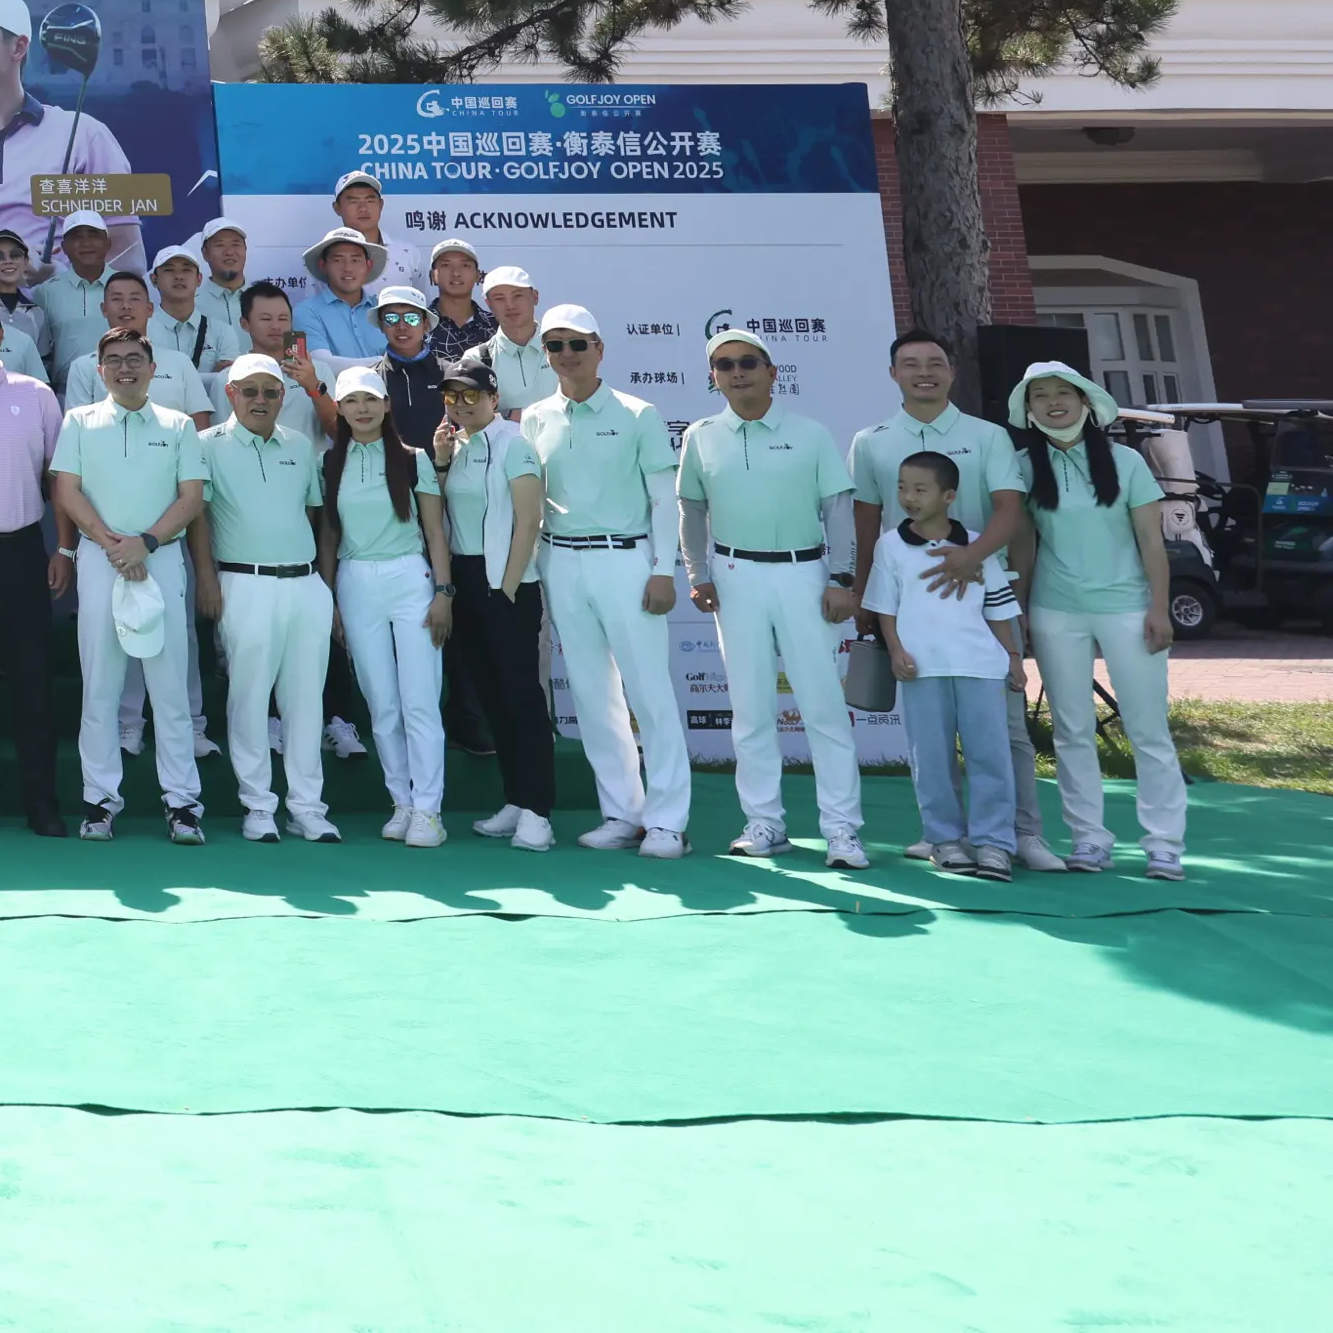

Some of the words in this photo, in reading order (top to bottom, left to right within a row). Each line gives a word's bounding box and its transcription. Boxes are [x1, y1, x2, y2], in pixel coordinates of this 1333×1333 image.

[450, 96, 518, 109] 中国巡回赛
[566, 94, 621, 105] GOLFJOY
[623, 94, 656, 105] OPEN
[360, 161, 429, 180] CHINA
[610, 161, 669, 179] OPEN
[673, 161, 724, 180] 2025
[38, 178, 107, 195] 查喜洋洋
[41, 199, 123, 213] SCHNEIDER
[129, 199, 157, 214] JAN
[405, 211, 446, 231] 鸣谢
[454, 212, 677, 229] ACKNOWLEDGEMENT
[627, 323, 674, 335] 认证单位
[745, 318, 827, 333] 中国巡回赛
[630, 372, 678, 384] 承办球场
